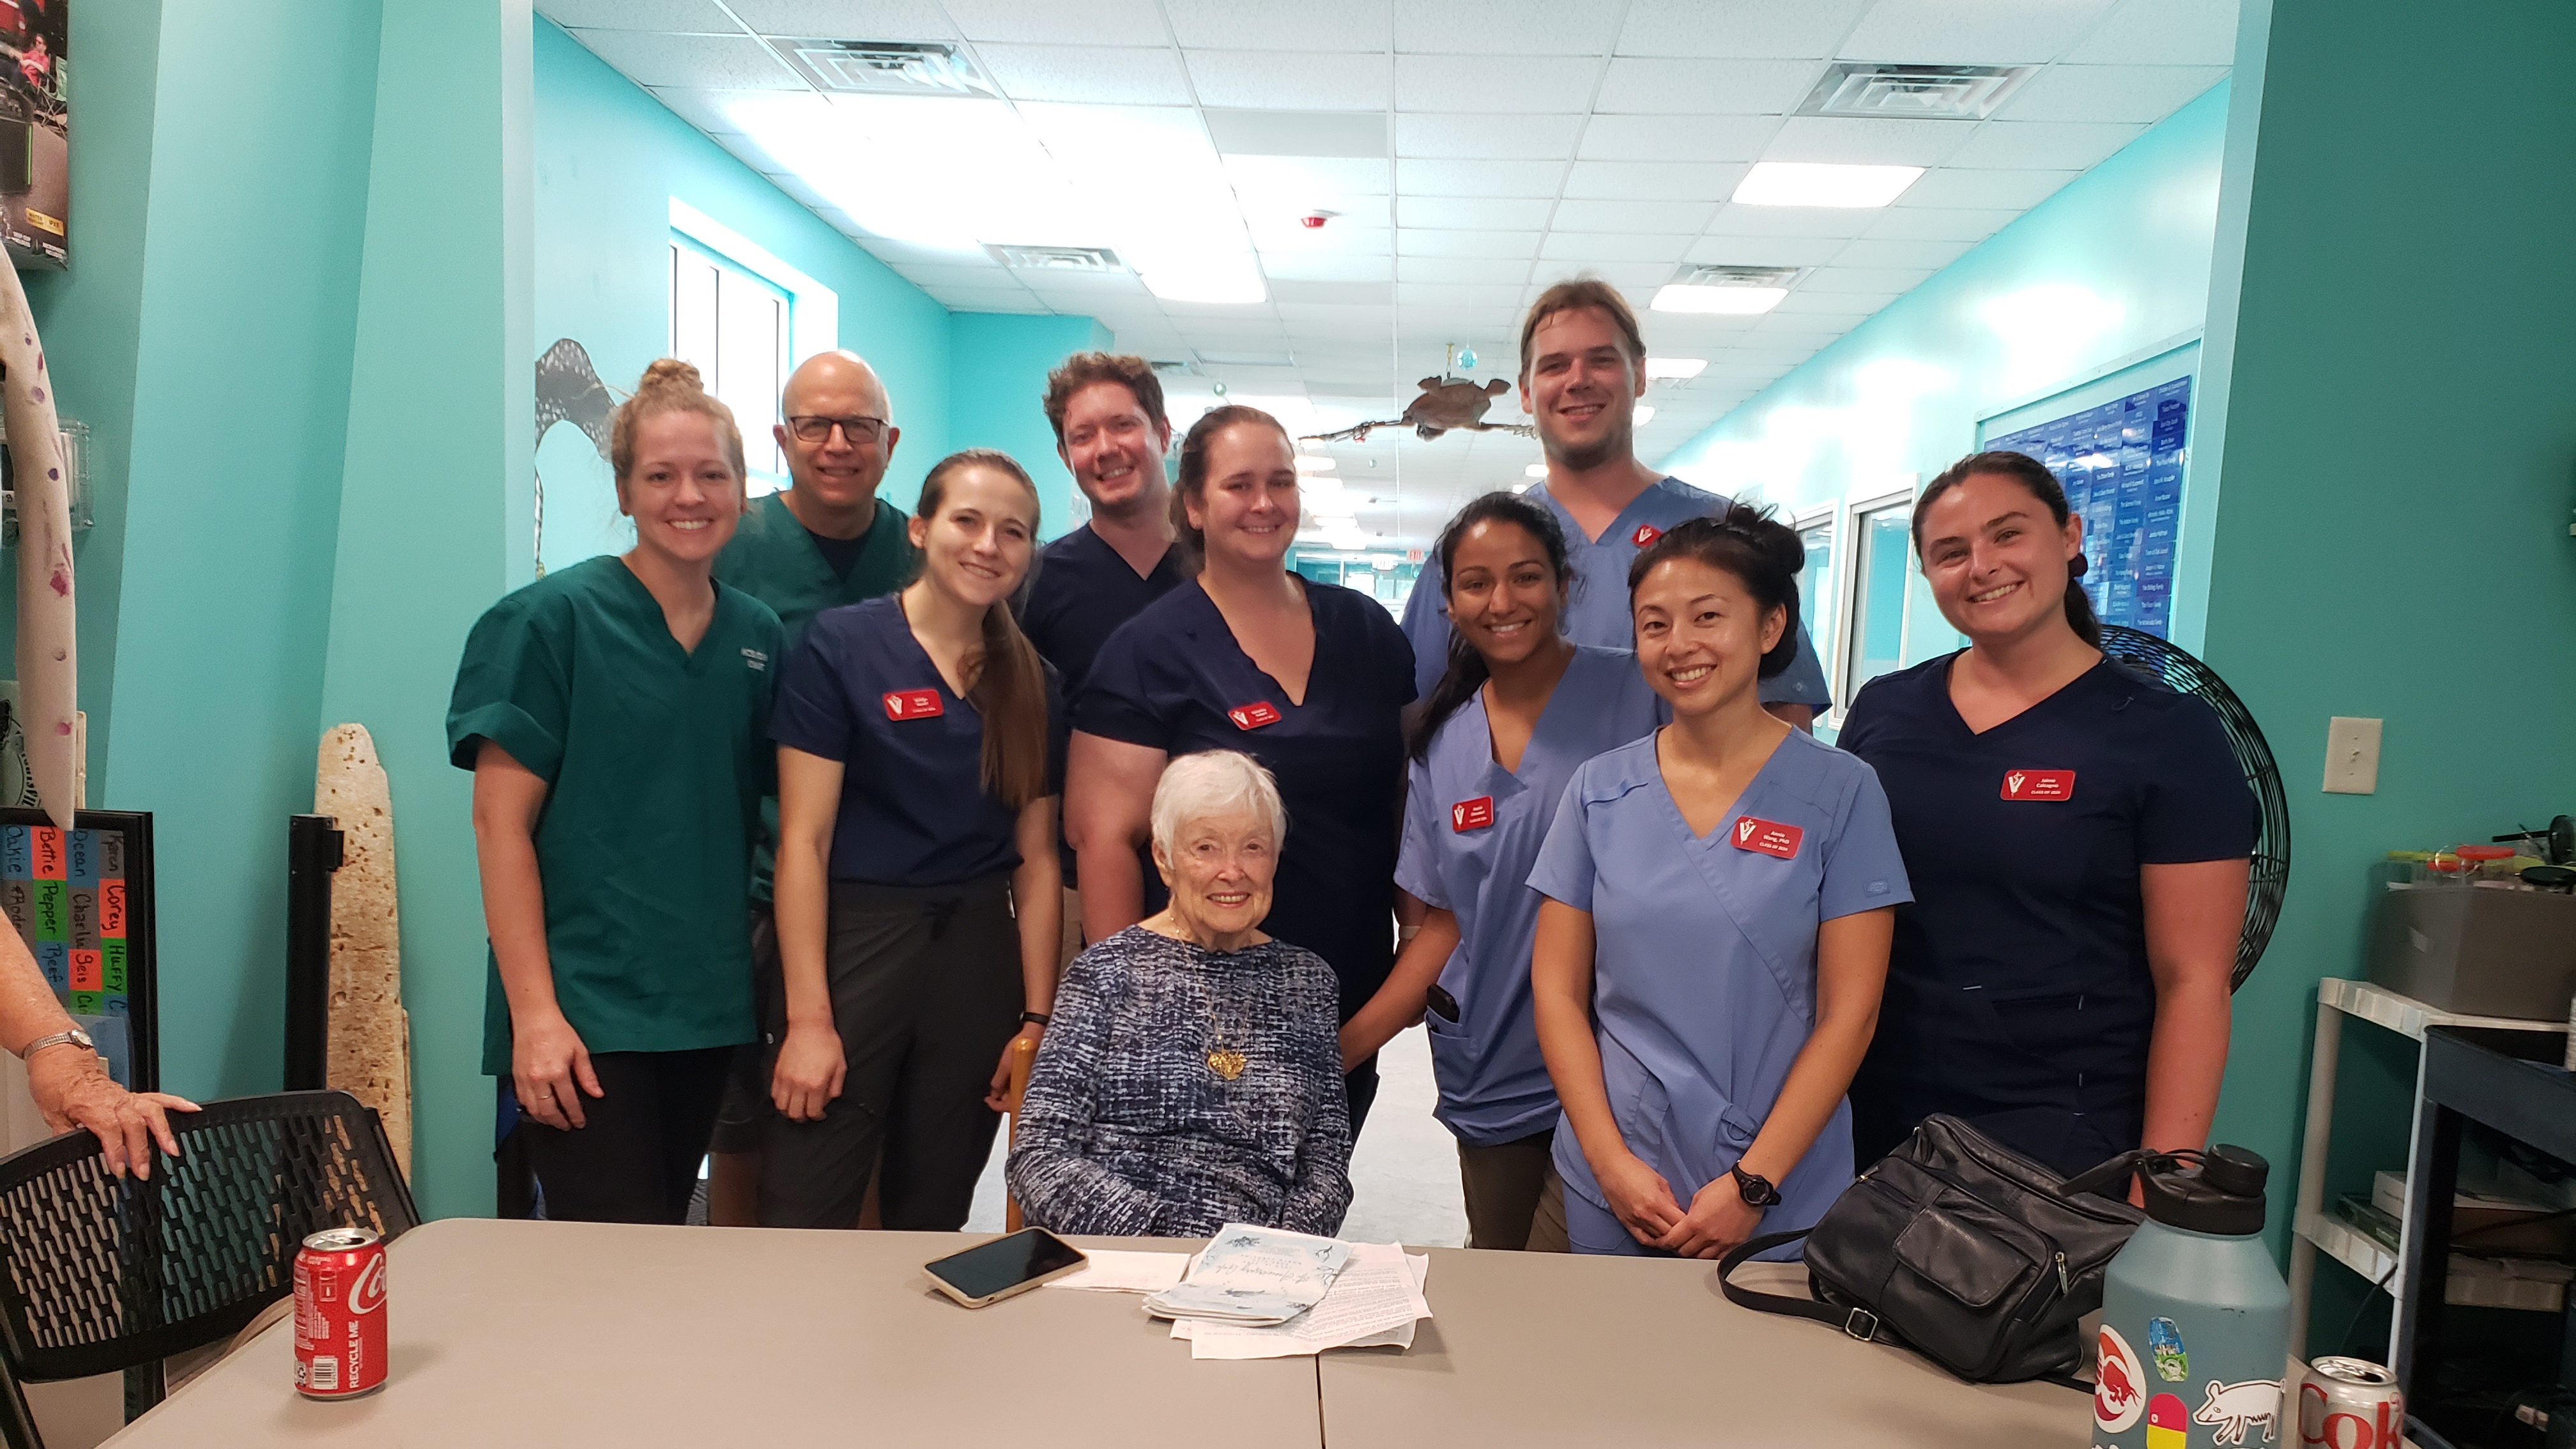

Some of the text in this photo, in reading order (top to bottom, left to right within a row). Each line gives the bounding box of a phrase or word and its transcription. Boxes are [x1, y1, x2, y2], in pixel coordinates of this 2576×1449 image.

[73, 830, 88, 878] Ocean
[38, 882, 59, 935] Pepper
[102, 884, 125, 931] Corey
[348, 1320, 360, 1389] RECYCLE ME
